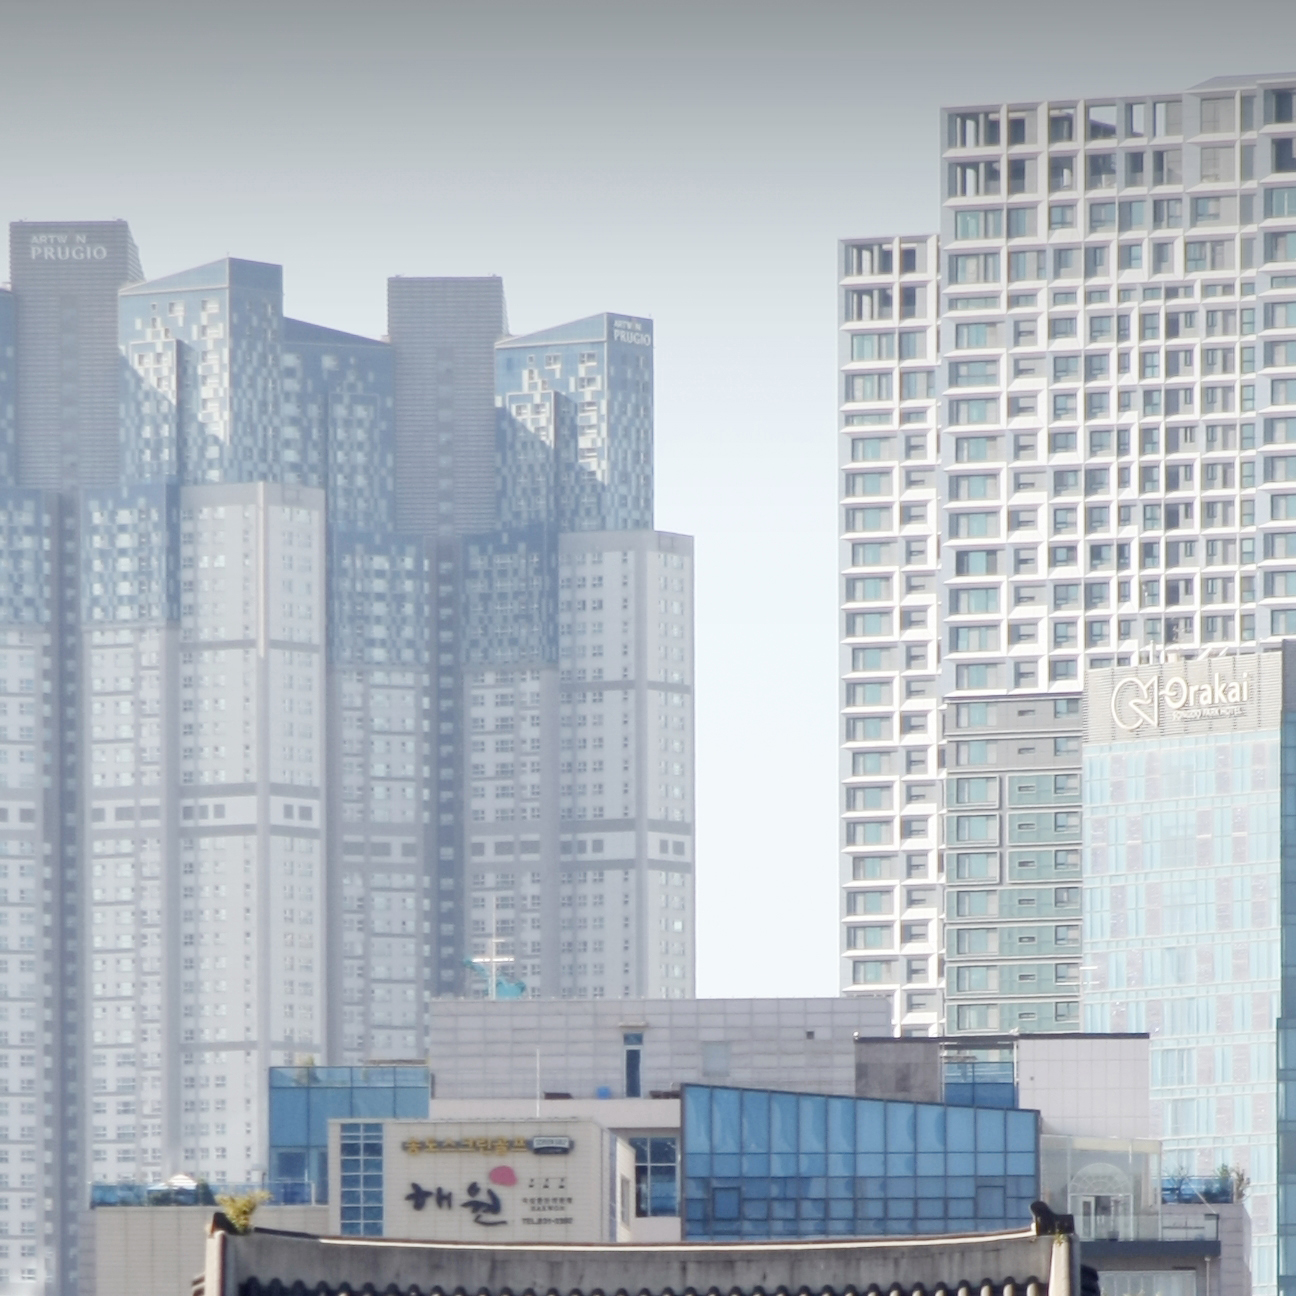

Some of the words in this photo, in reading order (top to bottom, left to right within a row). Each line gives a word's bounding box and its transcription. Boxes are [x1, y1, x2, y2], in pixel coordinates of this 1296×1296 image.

[31, 246, 108, 260] PRUGIO
[613, 329, 652, 347] PRUGIO
[1159, 672, 1249, 710] Orakai
[406, 1136, 528, 1156] 송도스크린골프
